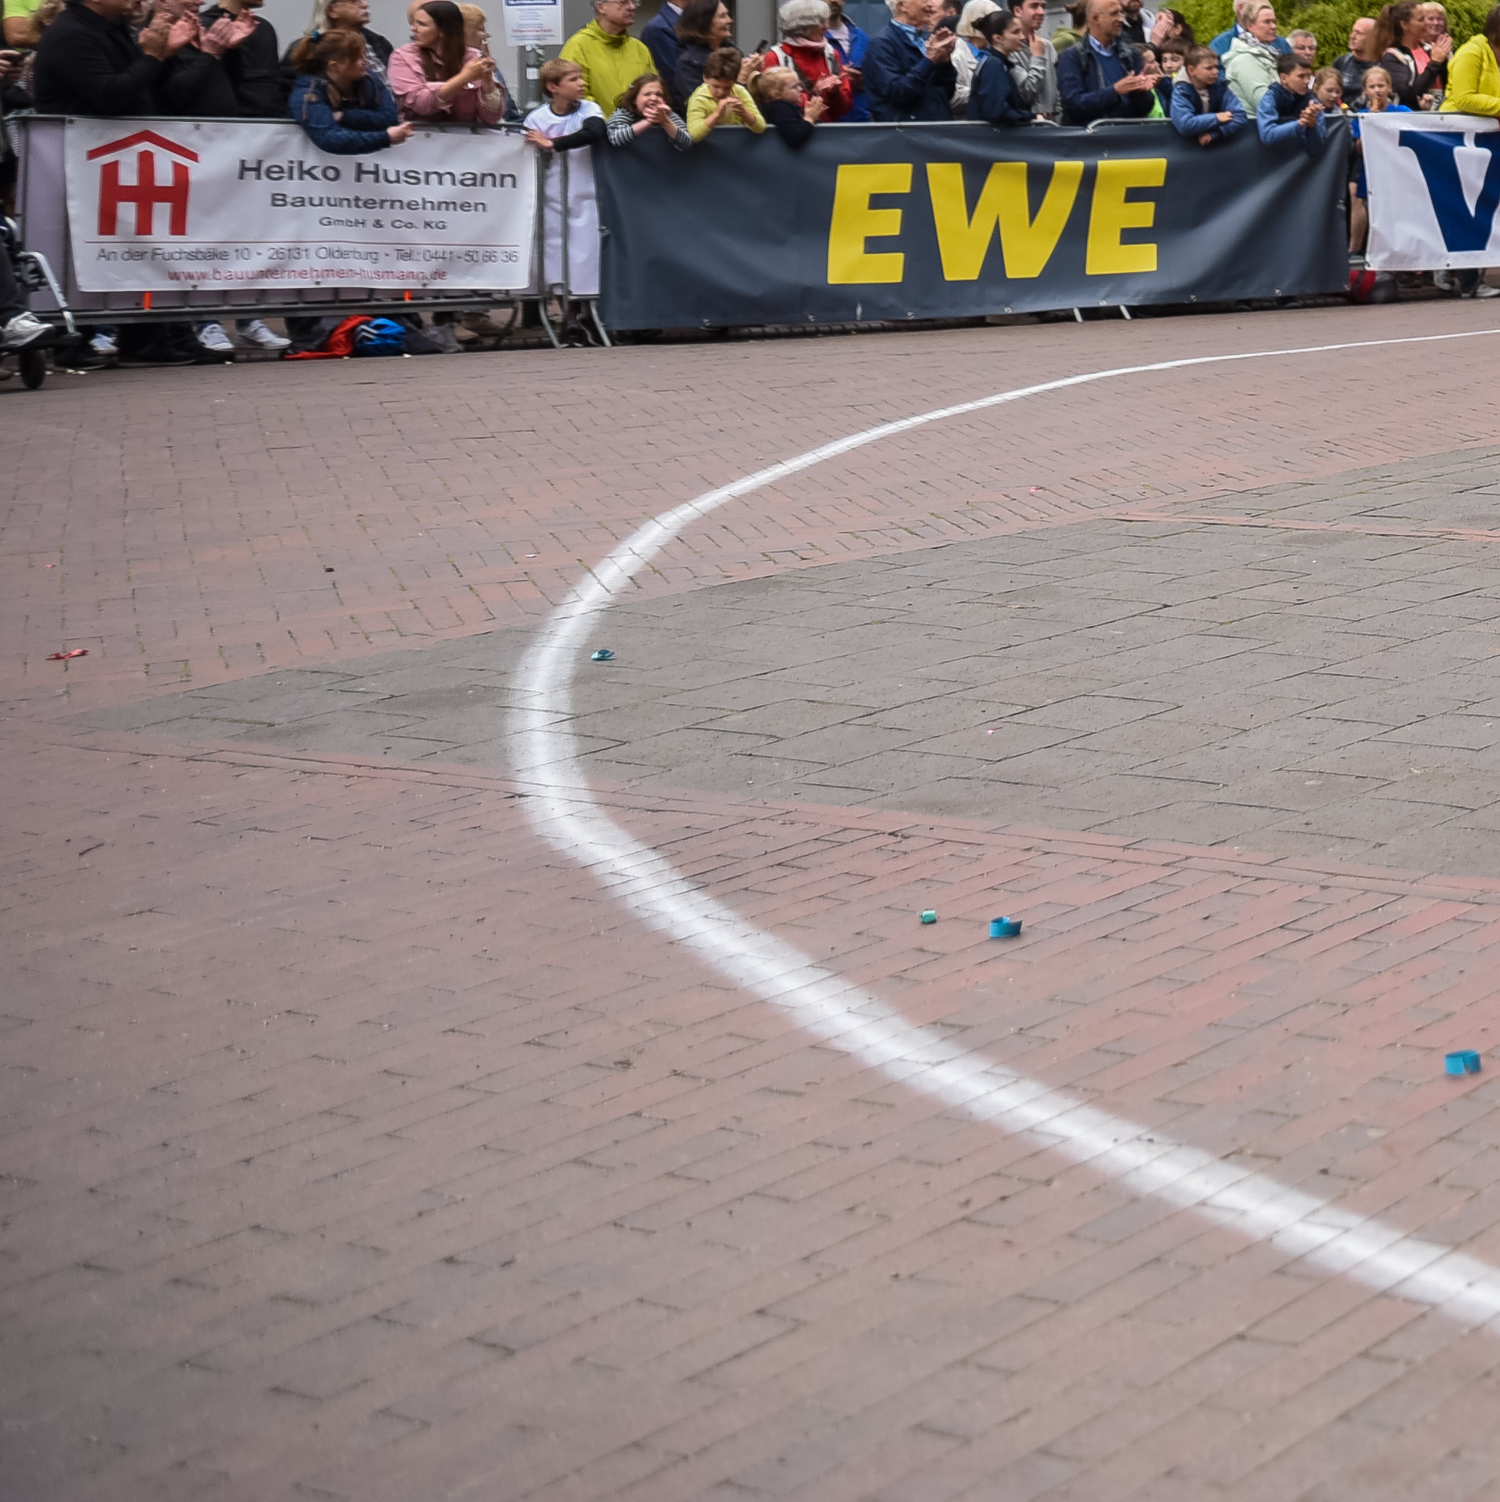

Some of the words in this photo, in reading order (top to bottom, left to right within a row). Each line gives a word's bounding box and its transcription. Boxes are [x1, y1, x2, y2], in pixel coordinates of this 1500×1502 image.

[237, 159, 342, 182] Heiko
[354, 162, 519, 189] Husmann
[270, 192, 488, 213] Bauunternehmen
[318, 216, 366, 228] GmbH
[372, 218, 385, 229] &
[390, 218, 419, 230] Co.
[423, 220, 447, 231] KG
[827, 157, 1168, 285] EWE
[96, 248, 117, 261] An
[120, 247, 149, 261] der
[235, 248, 250, 261] 10
